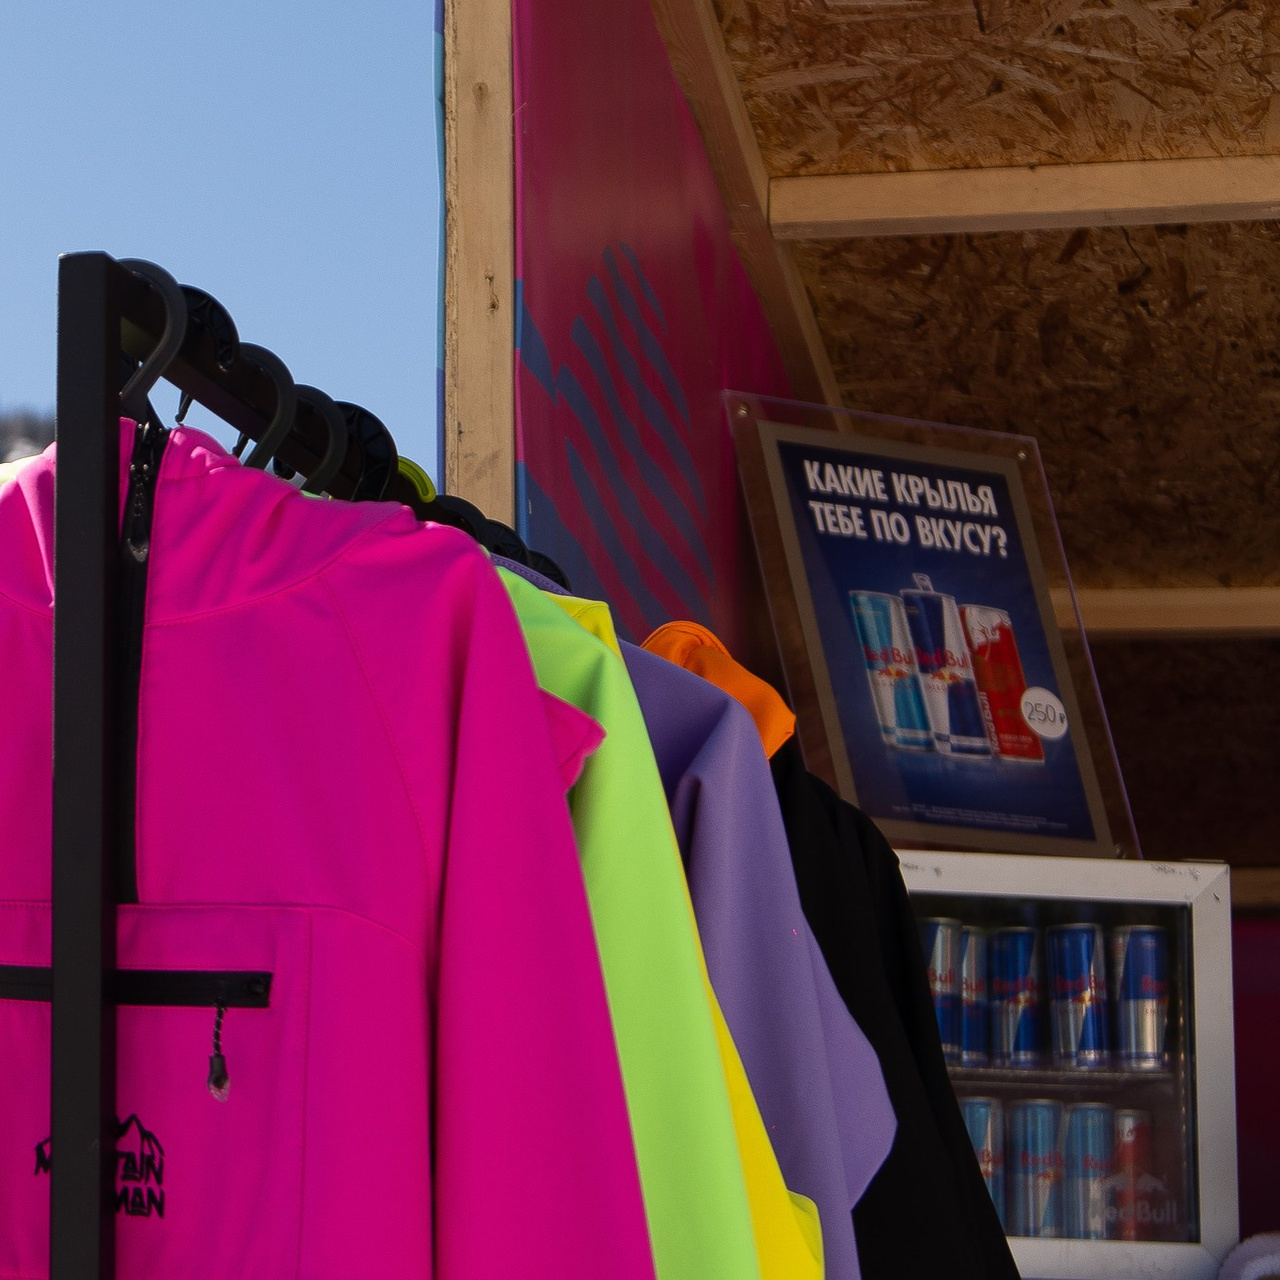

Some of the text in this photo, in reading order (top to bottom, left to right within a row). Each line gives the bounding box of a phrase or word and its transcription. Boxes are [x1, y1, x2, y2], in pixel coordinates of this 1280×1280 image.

[803, 459, 999, 518] КАКИЕ КРЫЛЬЯ
[808, 500, 1009, 559] ТЕБЕ ПО ВКУСУ?
[1024, 701, 1057, 724] 250
